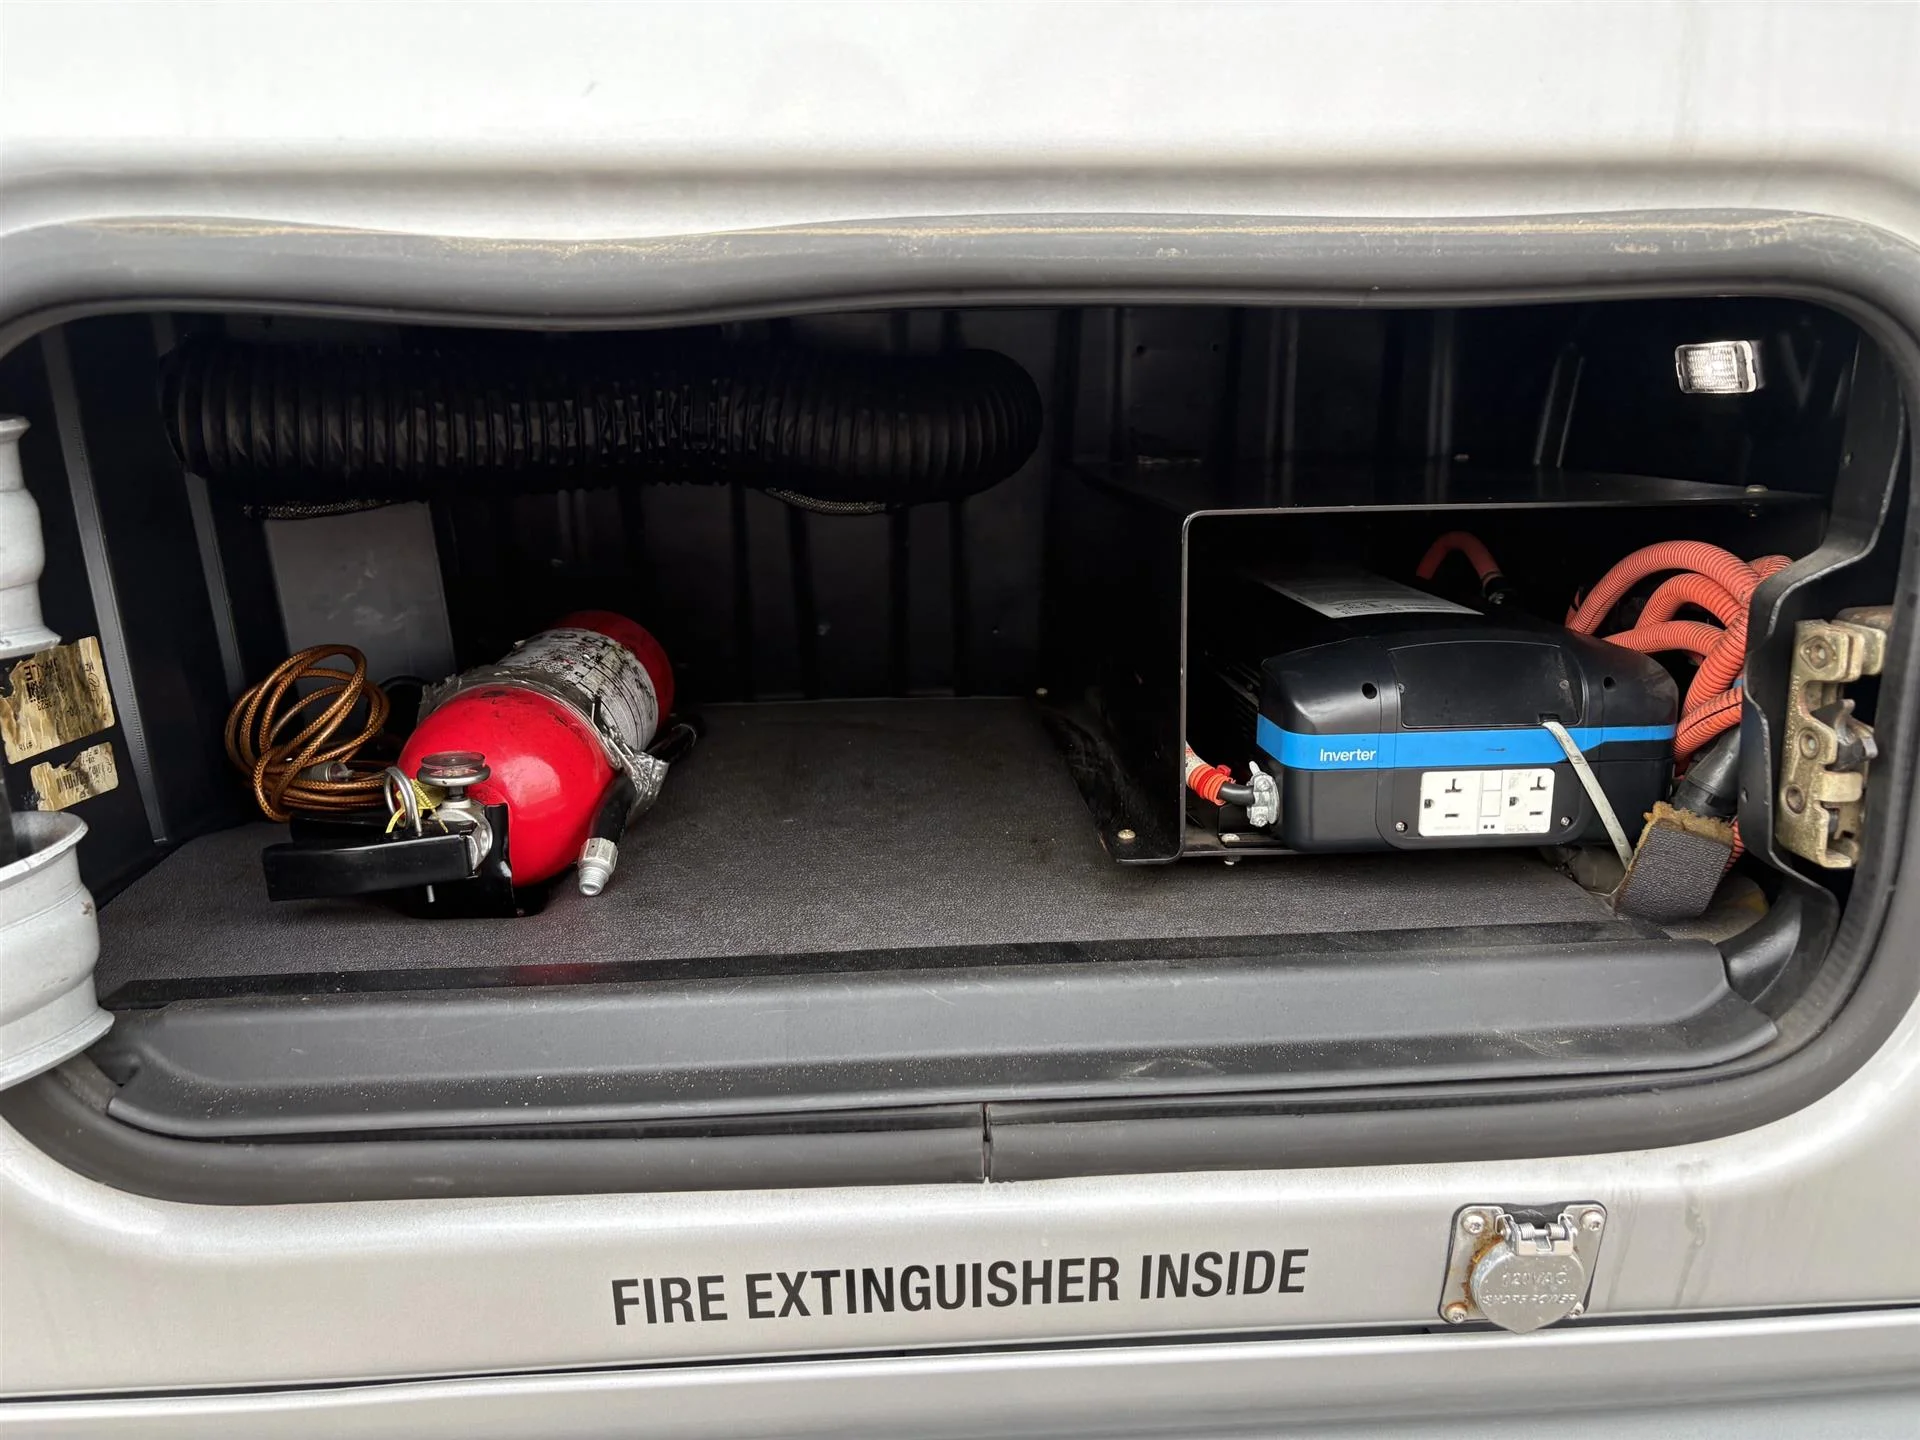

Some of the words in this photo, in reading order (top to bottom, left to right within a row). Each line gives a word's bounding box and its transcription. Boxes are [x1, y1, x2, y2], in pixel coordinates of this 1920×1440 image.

[1319, 748, 1377, 762] Inverter
[611, 1276, 728, 1326] FIRE
[745, 1256, 1120, 1319] EXTINGUISHER
[1140, 1248, 1309, 1300] INSIDE
